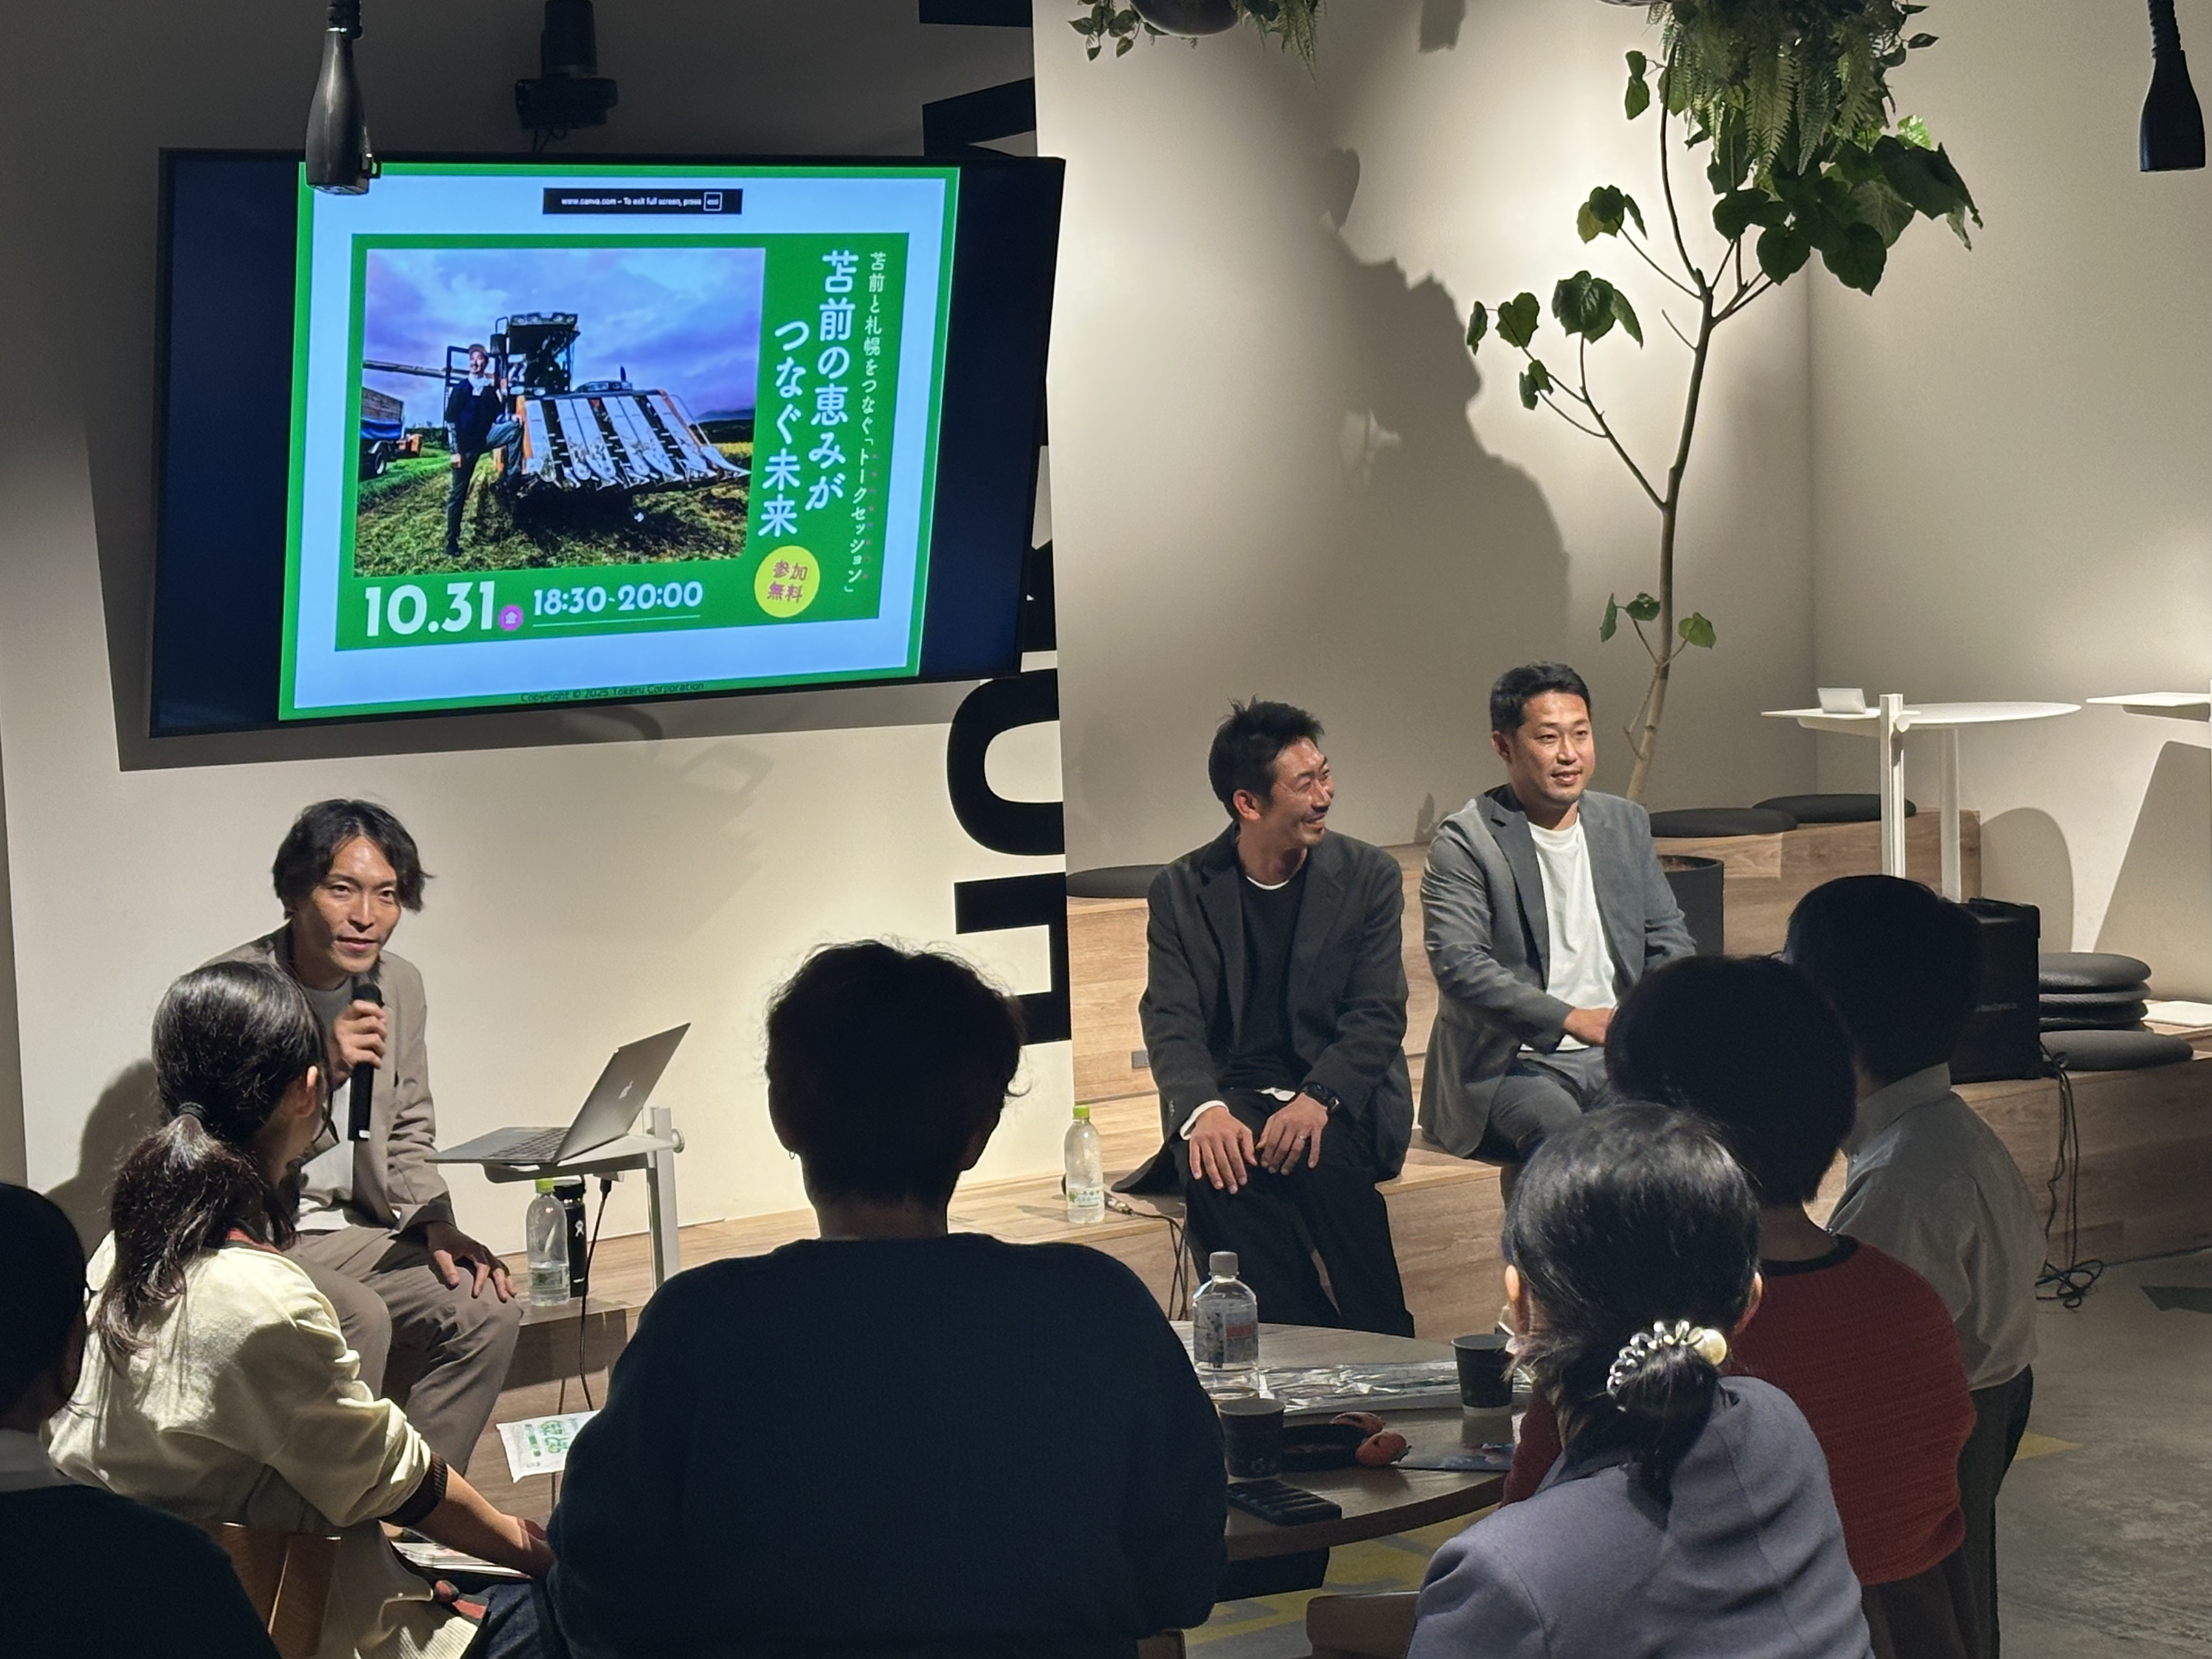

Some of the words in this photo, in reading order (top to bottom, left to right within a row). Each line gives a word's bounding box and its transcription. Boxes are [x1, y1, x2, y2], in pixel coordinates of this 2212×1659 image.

[623, 197, 632, 205] To
[633, 197, 645, 205] exit
[646, 197, 657, 205] full
[805, 249, 860, 512] 苫前の恵みが
[758, 320, 809, 538] つなぐ未来
[772, 559, 808, 581] 参加
[766, 581, 804, 603] 無料
[365, 581, 496, 637] 10.31
[520, 691, 569, 702] Copyright
[585, 688, 609, 698] 2025
[647, 683, 704, 694] Corporation
